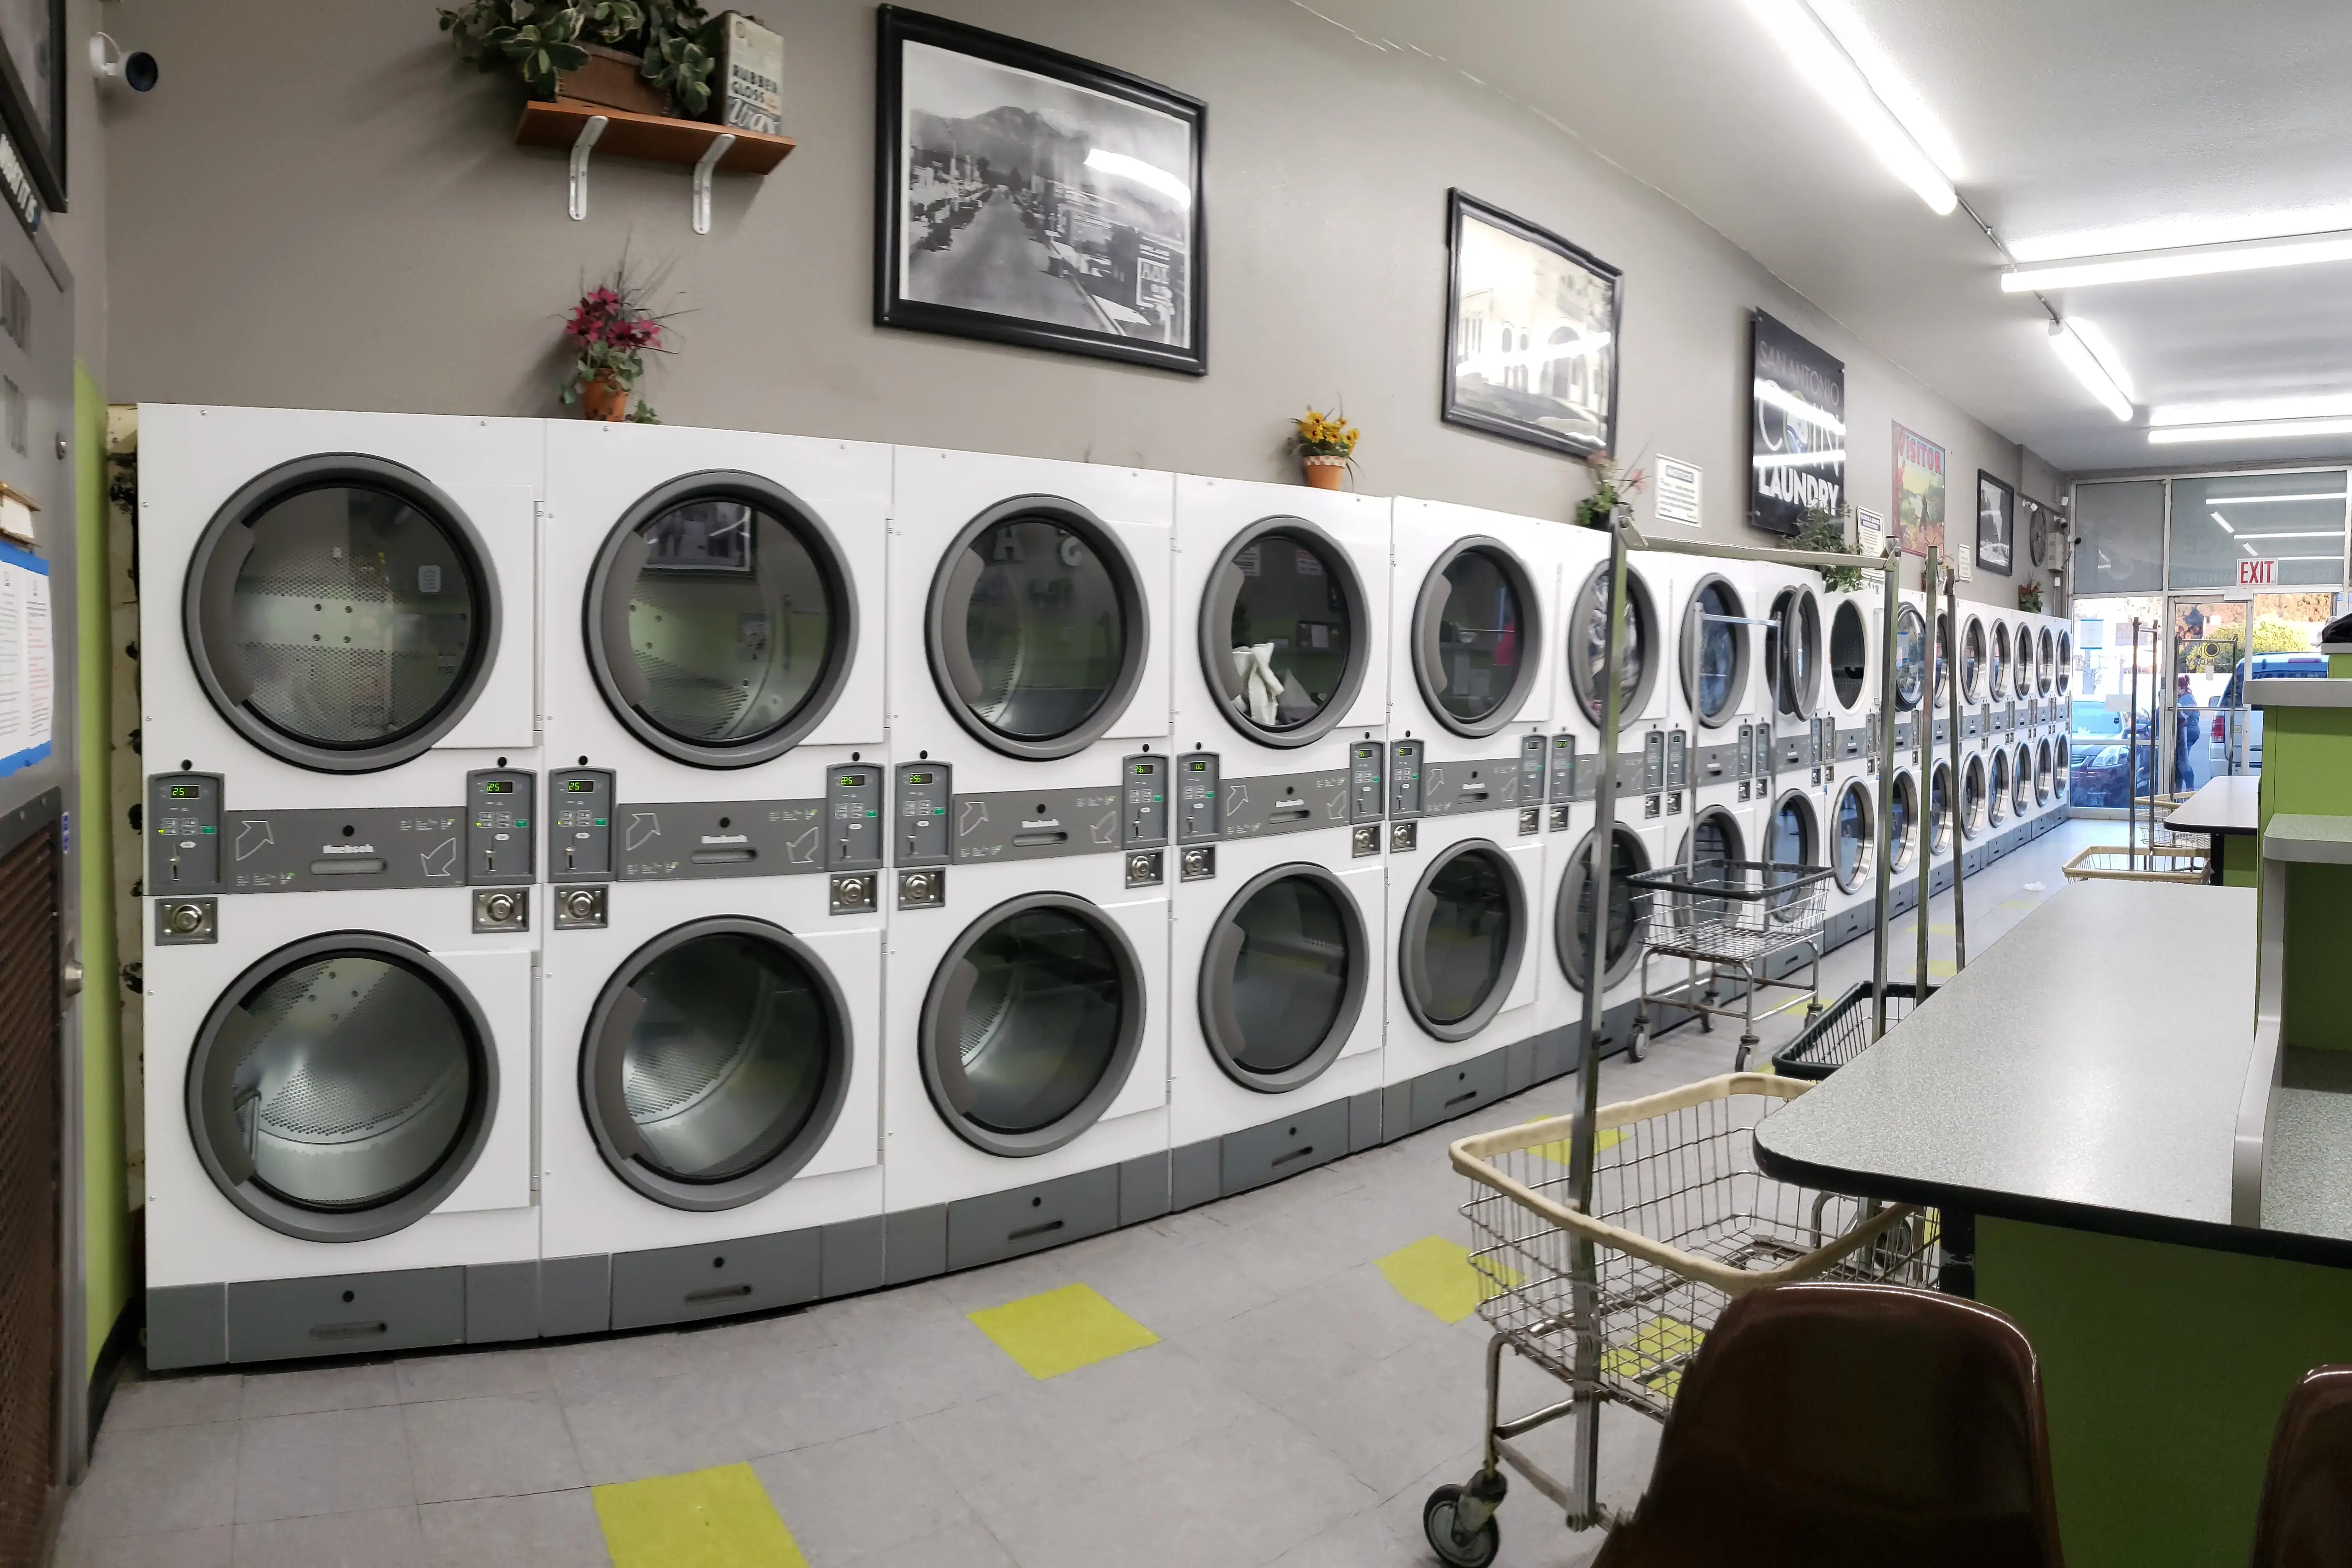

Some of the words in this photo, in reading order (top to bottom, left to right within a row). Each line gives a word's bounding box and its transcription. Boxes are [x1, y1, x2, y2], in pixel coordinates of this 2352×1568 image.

[1788, 358, 1839, 406] ANTONIO
[1897, 428, 1941, 475] VISITOR
[1759, 465, 1839, 516] LAUNDRY
[2240, 561, 2274, 584] EXIT
[172, 787, 184, 796] 25
[569, 782, 579, 790] 25
